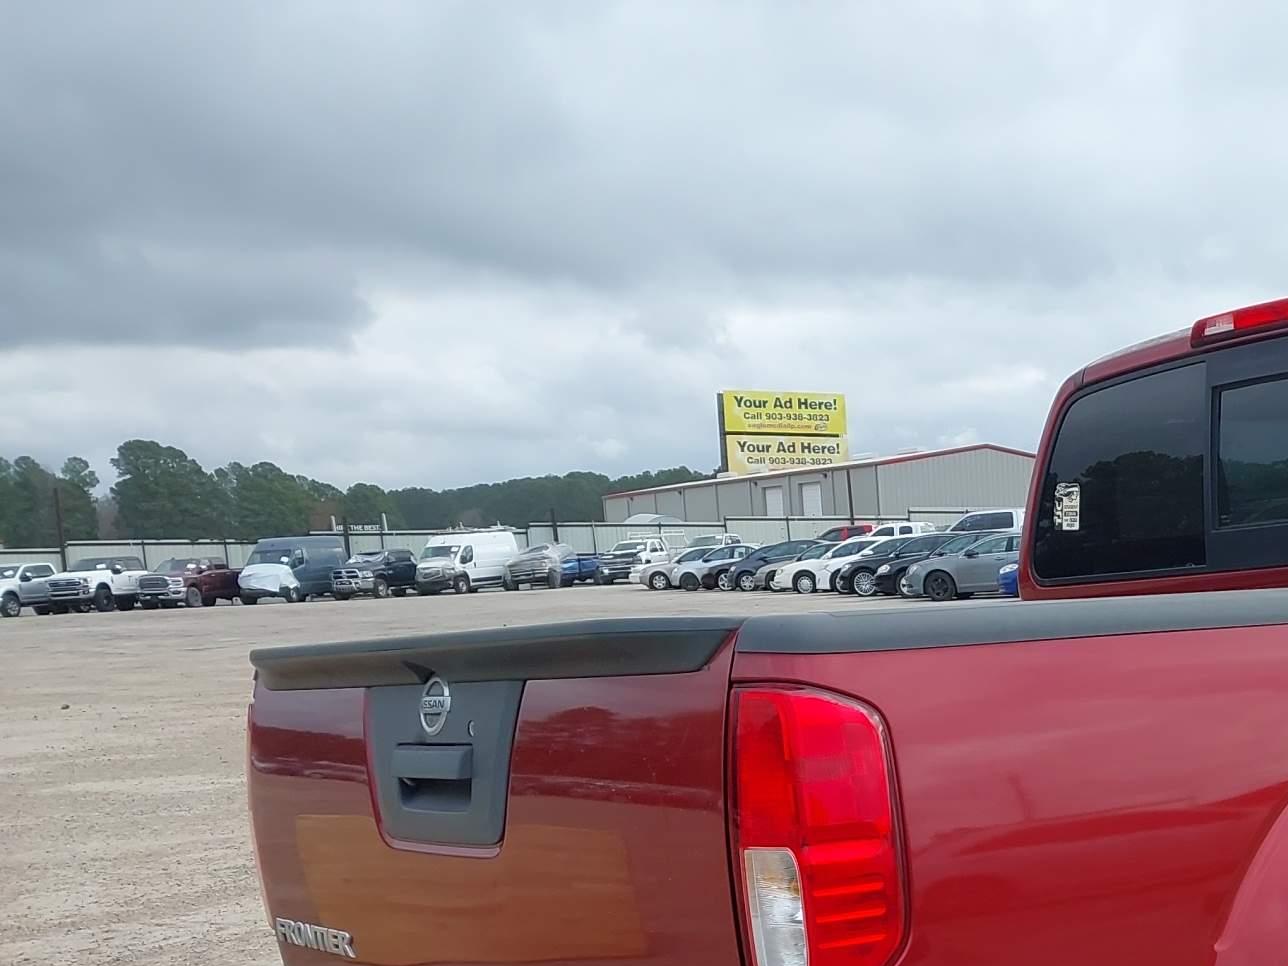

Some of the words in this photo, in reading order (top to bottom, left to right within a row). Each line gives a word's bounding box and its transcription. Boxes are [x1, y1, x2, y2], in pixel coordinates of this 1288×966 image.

[733, 396, 768, 408] Your
[773, 397, 793, 409] Ad
[797, 398, 838, 410] Here!
[743, 411, 763, 420] Call
[736, 440, 772, 453] Your
[776, 441, 796, 454] Ad
[800, 442, 840, 454] Here!
[746, 456, 766, 465] Call
[423, 699, 445, 709] SSAN
[275, 917, 357, 959] FRONTIER
